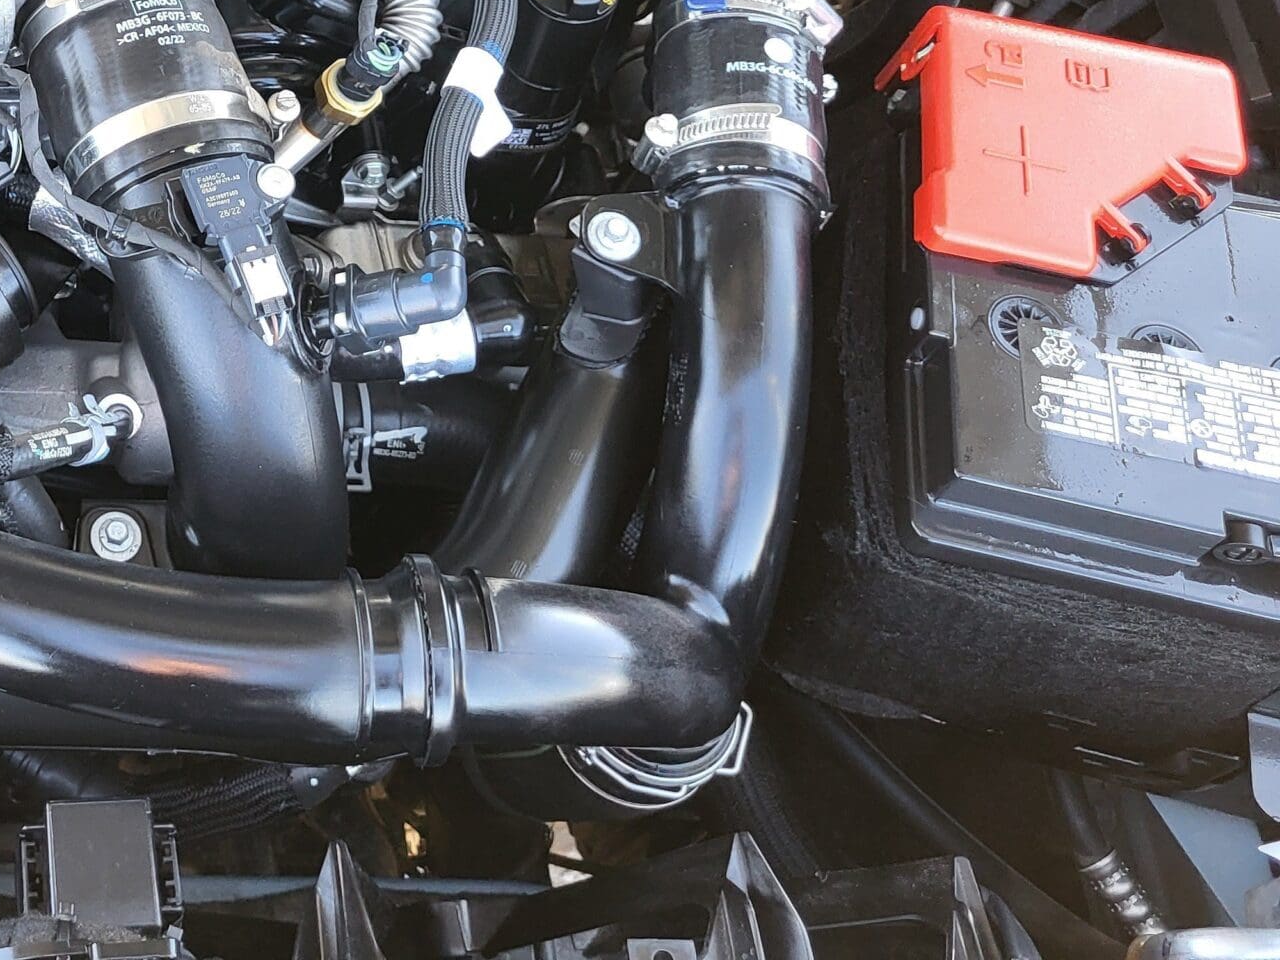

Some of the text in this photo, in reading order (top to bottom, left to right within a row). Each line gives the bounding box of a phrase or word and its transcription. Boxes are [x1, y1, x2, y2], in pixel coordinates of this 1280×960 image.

[176, 22, 210, 34] MEXICO
[157, 35, 186, 46] 02/22
[197, 172, 226, 184] FoMoCo
[219, 206, 242, 219] 28/22
